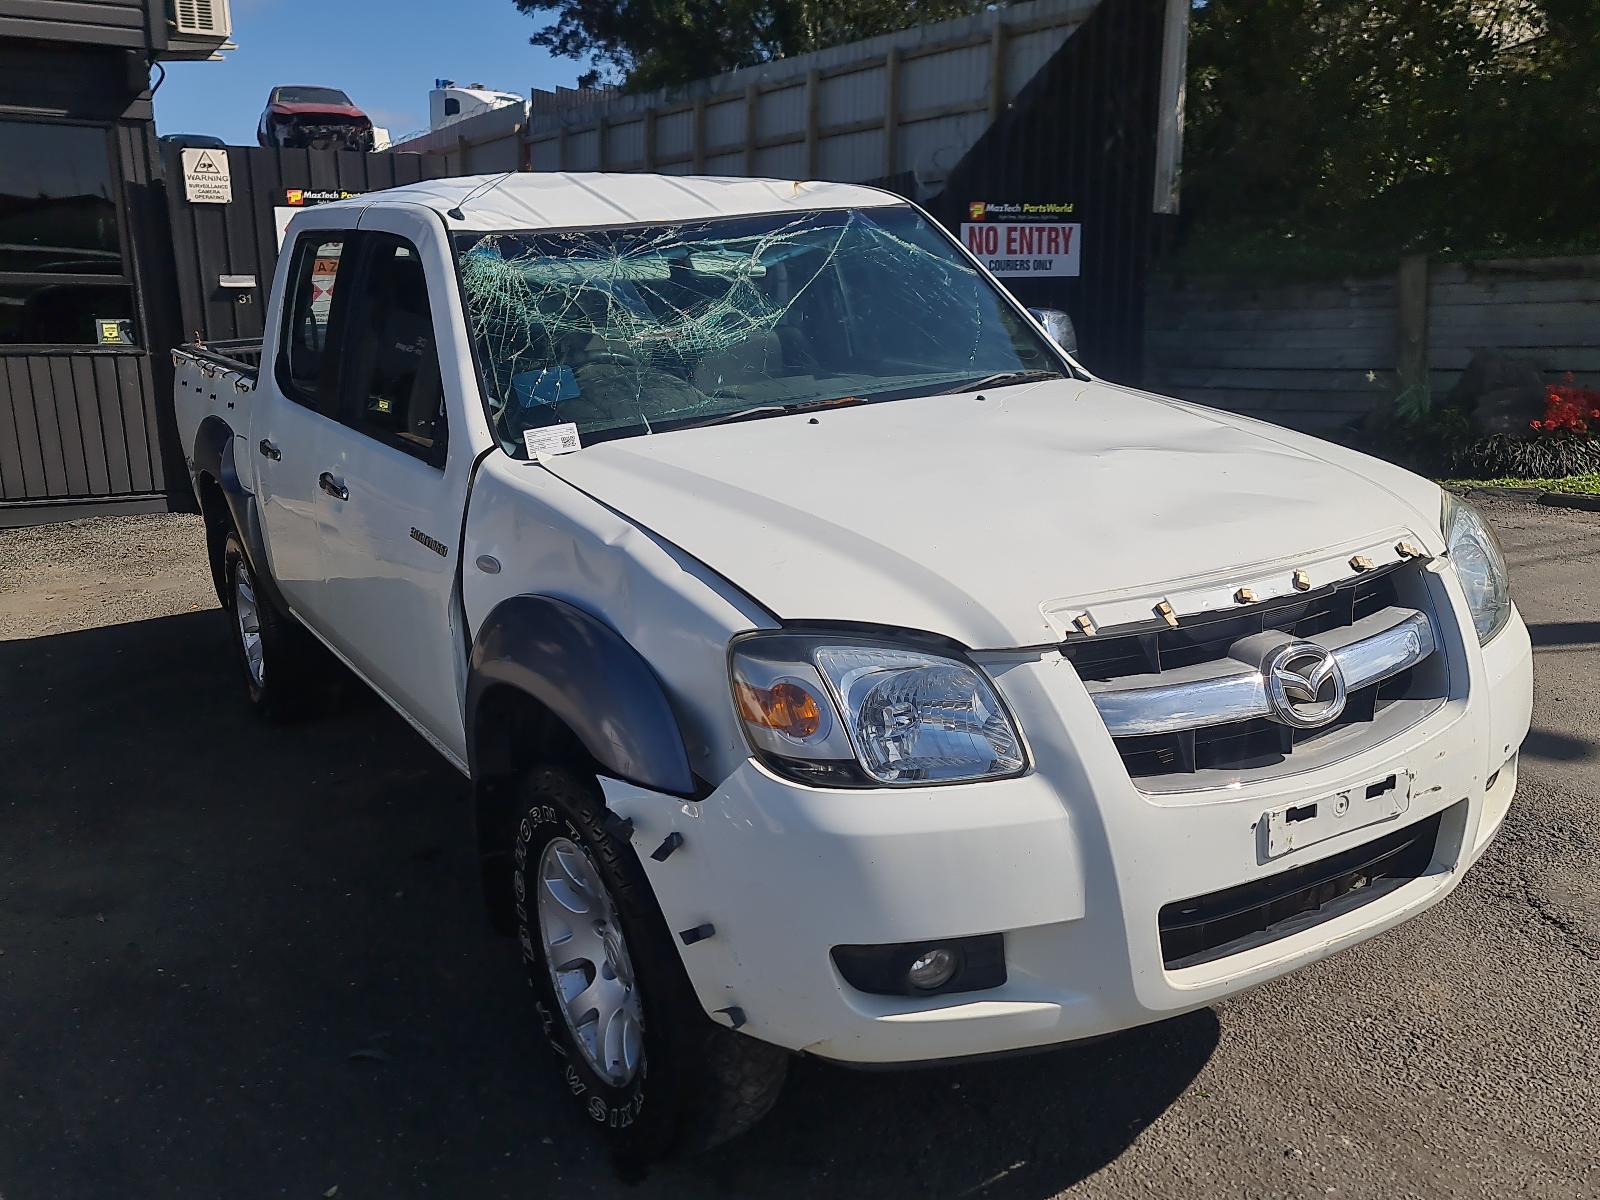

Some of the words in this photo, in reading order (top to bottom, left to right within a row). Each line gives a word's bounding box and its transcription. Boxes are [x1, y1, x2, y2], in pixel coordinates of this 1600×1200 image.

[186, 174, 229, 182] WARNING
[968, 226, 999, 256] NO
[1006, 226, 1074, 256] ENTRY
[988, 260, 1031, 272] COURIERS
[1033, 260, 1054, 271] ONLY
[238, 294, 252, 304] 31
